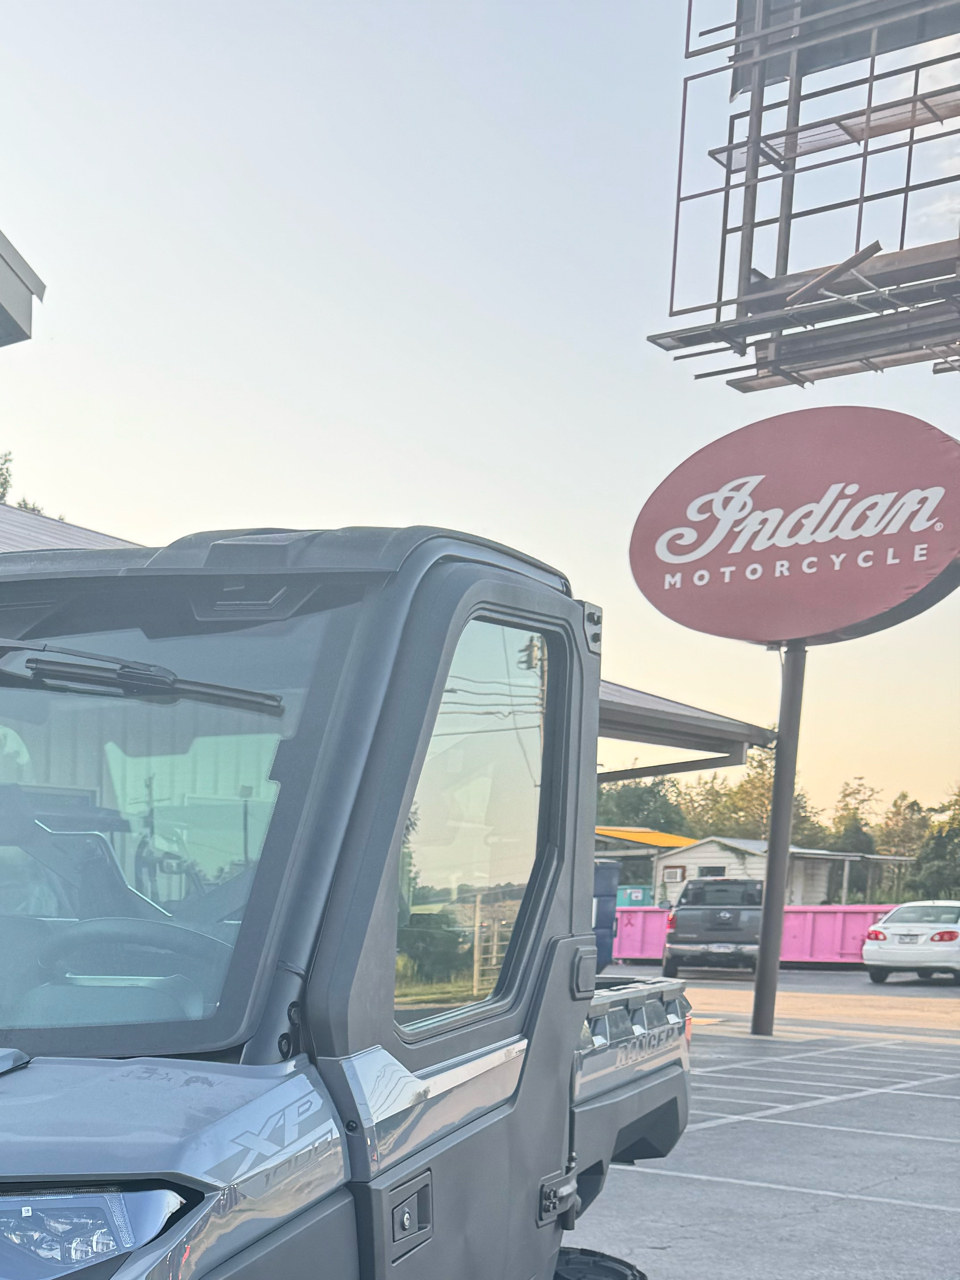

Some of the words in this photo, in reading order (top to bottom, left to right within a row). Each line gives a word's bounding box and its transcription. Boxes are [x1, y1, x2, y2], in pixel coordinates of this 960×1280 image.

[655, 475, 946, 564] Indian
[664, 544, 928, 590] MOTORCYCLE
[230, 1089, 324, 1181] XP
[264, 1127, 334, 1189] 1000
